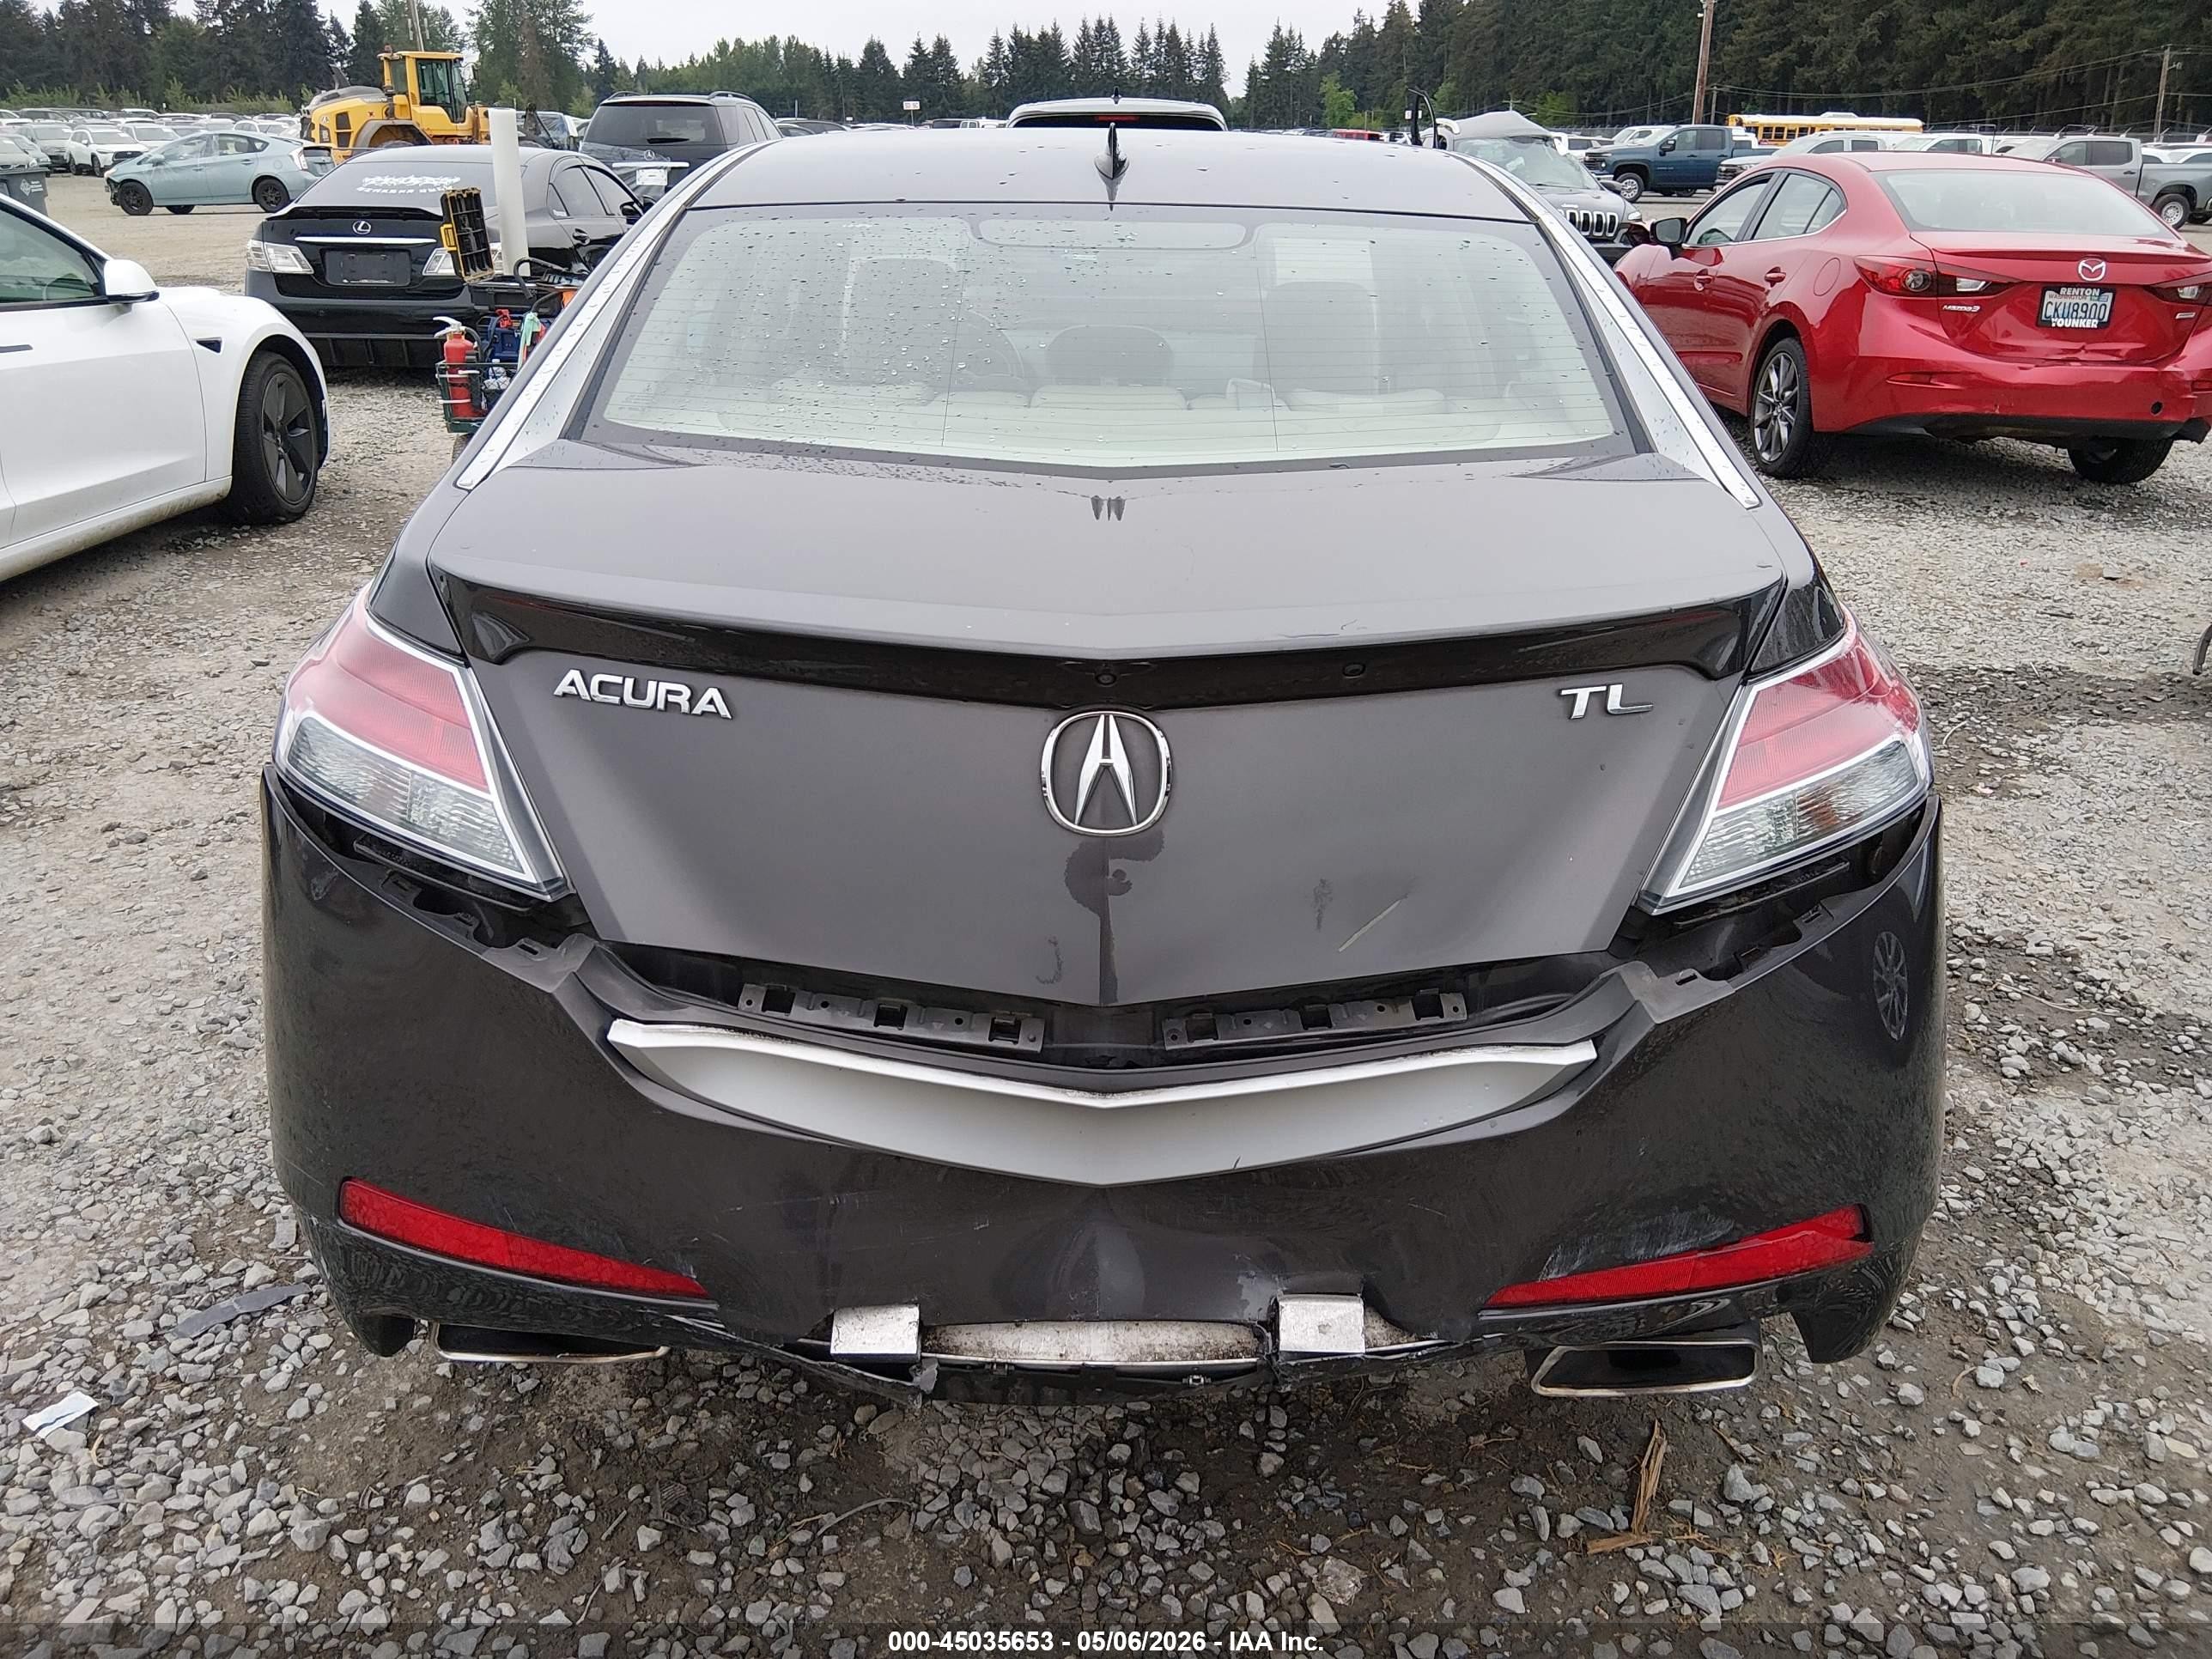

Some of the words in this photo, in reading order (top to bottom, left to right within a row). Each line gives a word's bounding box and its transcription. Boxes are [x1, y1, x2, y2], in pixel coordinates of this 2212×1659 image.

[2060, 287, 2100, 296] RENTON
[2051, 317, 2100, 329] YOUNKER
[553, 668, 732, 720] ACURA
[1559, 684, 1654, 720] TL
